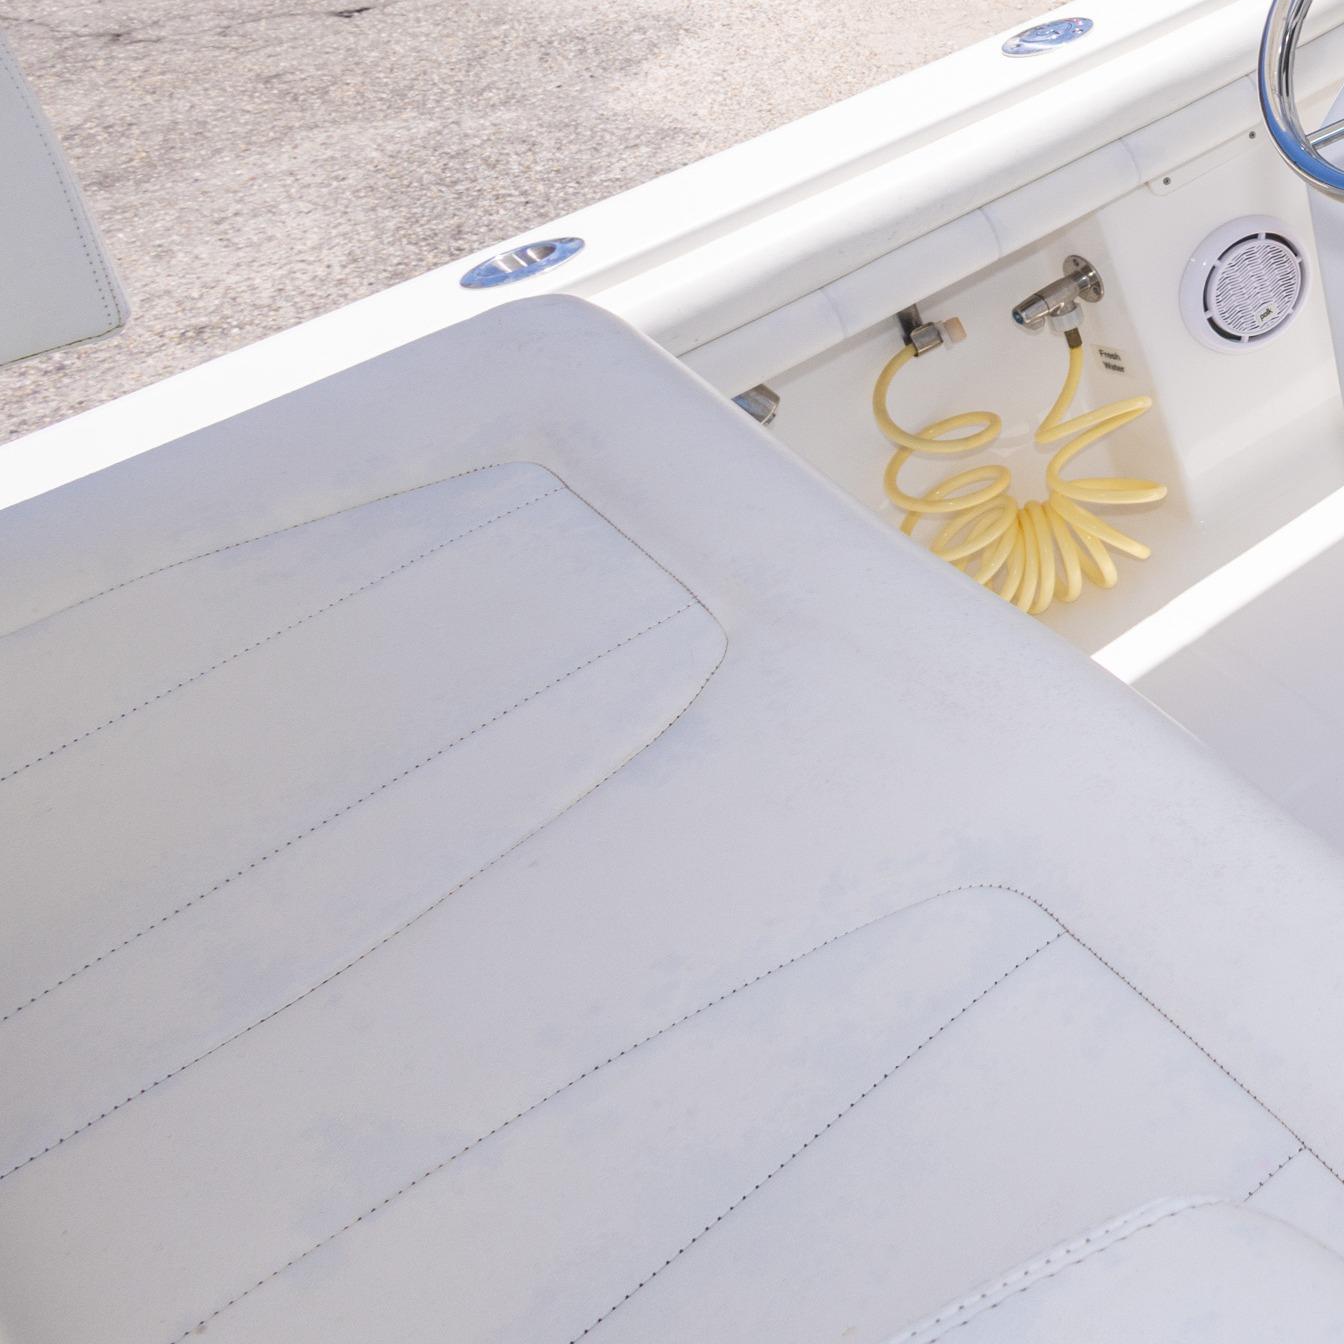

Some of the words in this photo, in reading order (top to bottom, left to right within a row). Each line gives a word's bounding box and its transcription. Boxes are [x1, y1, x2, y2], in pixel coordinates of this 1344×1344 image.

[1259, 308, 1273, 322] polk
[1098, 349, 1122, 361] Fresh
[1102, 361, 1125, 373] Water
